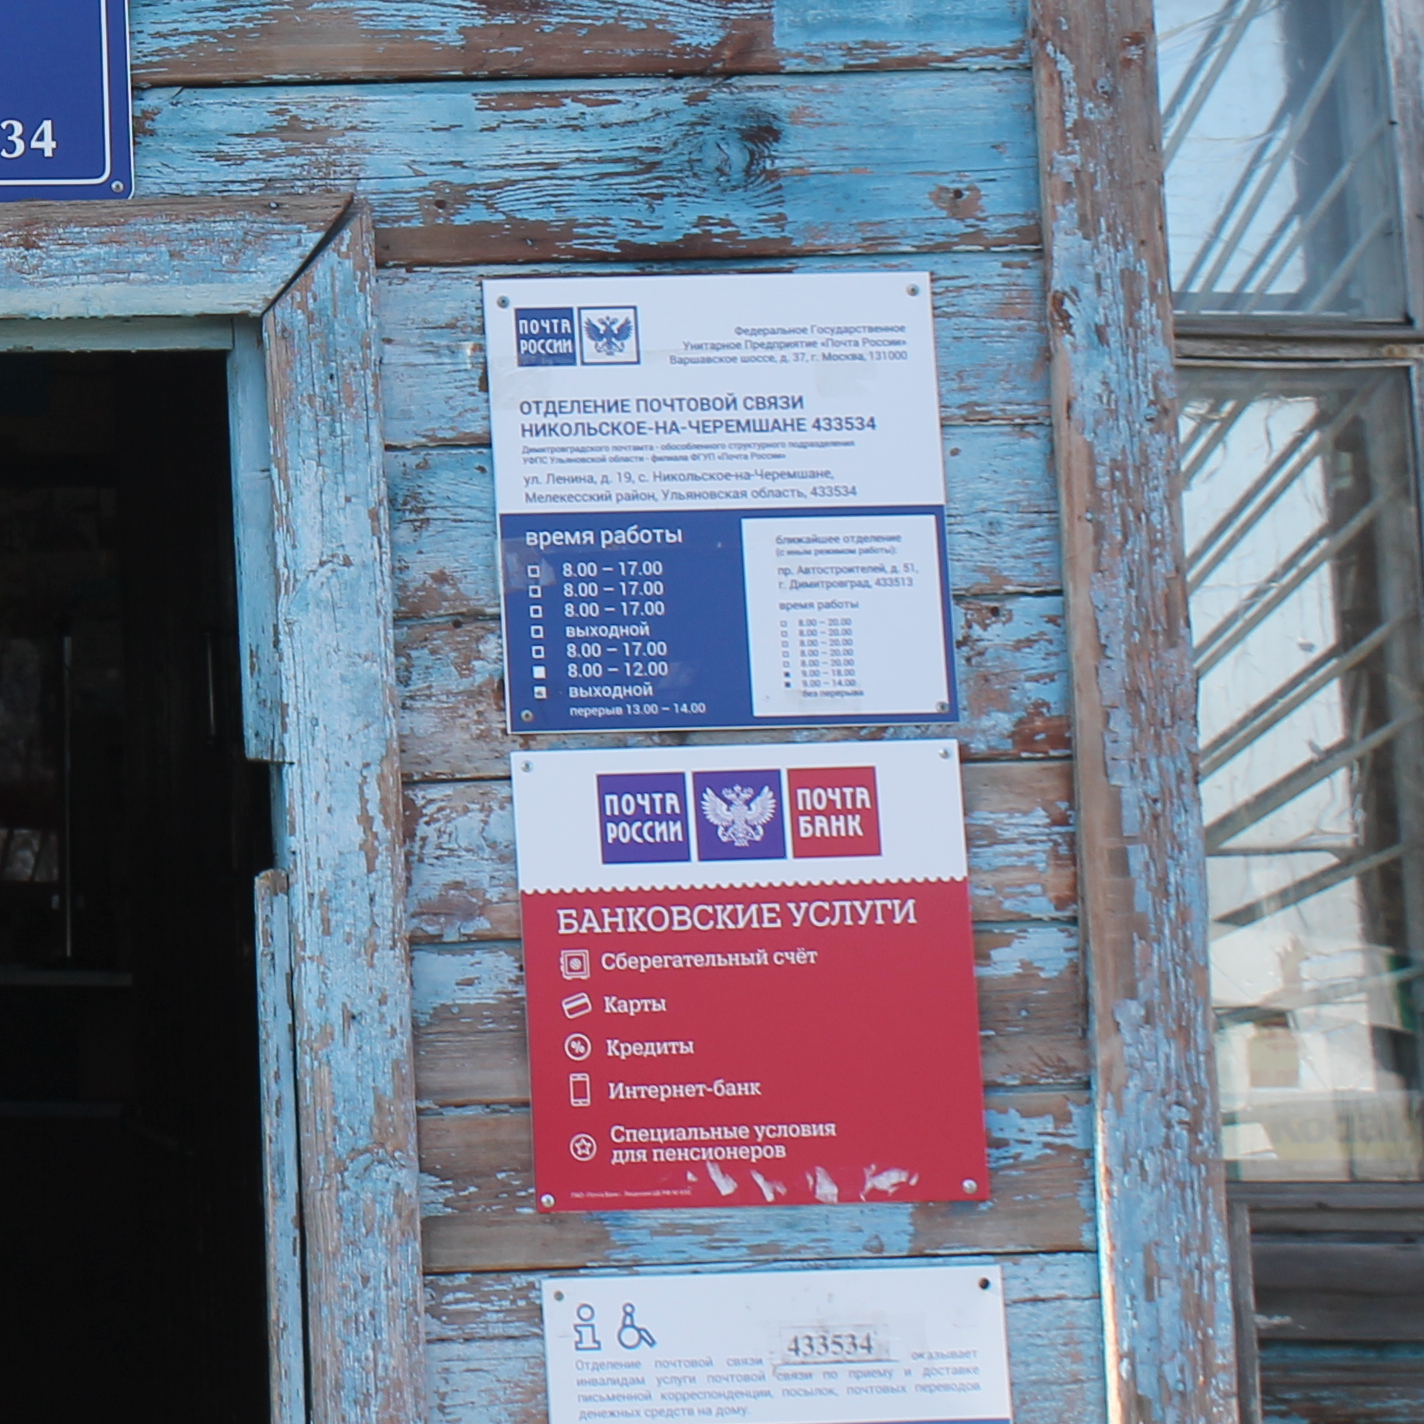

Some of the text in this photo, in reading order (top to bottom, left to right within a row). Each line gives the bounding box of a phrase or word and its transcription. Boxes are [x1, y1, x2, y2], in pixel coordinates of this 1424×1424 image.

[518, 319, 572, 335] ПОЧТА
[735, 324, 906, 337] Федеральное Государственное
[519, 338, 573, 354] РОССИИ
[683, 338, 907, 352] Унитарное Предприятие «Почта России»
[669, 354, 738, 366] Варшавское
[740, 354, 777, 364] шоссе,
[822, 352, 866, 363] Москва,
[870, 351, 908, 361] 131000
[519, 393, 805, 417] ОТДЕЛЕНИЕ ПОЧТОВОЙ СВЯЗИ
[520, 416, 877, 438] НИКОЛЬСКОЕ-НА-ЧЕРЕМШАНЕ 433534
[523, 468, 834, 488] ул. Ленина, д. 19, с. Никольское-на-Черемшане,
[525, 485, 857, 505] Мелекесский район, Ульяновская область, 433534
[525, 524, 683, 550] время работы
[842, 534, 902, 544] отделение
[562, 560, 663, 578] 8.00 17.00
[563, 580, 664, 598] 8.00 17.00
[564, 601, 665, 618] 8.00 17.00
[778, 599, 859, 612] время работы
[565, 621, 650, 639] выходной
[566, 641, 668, 658] 8.00 17.00
[567, 661, 669, 678] 8.00 12.00
[568, 681, 653, 700] выходной
[569, 702, 707, 718] перерыв 13.00 14.00
[605, 793, 680, 817] ПОЧТА
[797, 786, 871, 812] ПОЧТА
[606, 819, 684, 844] РОССИИ
[799, 813, 864, 839] БАНК
[557, 899, 917, 936] БАНКОВСКИЕ УСЛУГИ
[600, 947, 818, 975] Сберегательный счёт
[603, 995, 666, 1016] Карты
[606, 1037, 694, 1059] Кредиты
[607, 1079, 762, 1101] Интернет-банк
[610, 1121, 837, 1144] Специальные условия
[611, 1141, 787, 1165] для пенсионеров
[575, 1332, 978, 1372] Отделение почтовой связи 433534 оказывает
[576, 1376, 646, 1388] инвалидам
[656, 1375, 696, 1387] услуги
[706, 1372, 766, 1384] почтовой
[777, 1370, 813, 1380] связи
[822, 1370, 838, 1380] по
[848, 1368, 894, 1381] приему
[922, 1365, 980, 1378] доставке
[577, 1390, 652, 1404] письменной
[660, 1388, 774, 1402] корреспонденции,
[847, 1384, 907, 1396] почтовых
[914, 1381, 981, 1395] переводов
[579, 1405, 750, 1421] денежных средств на дому.
